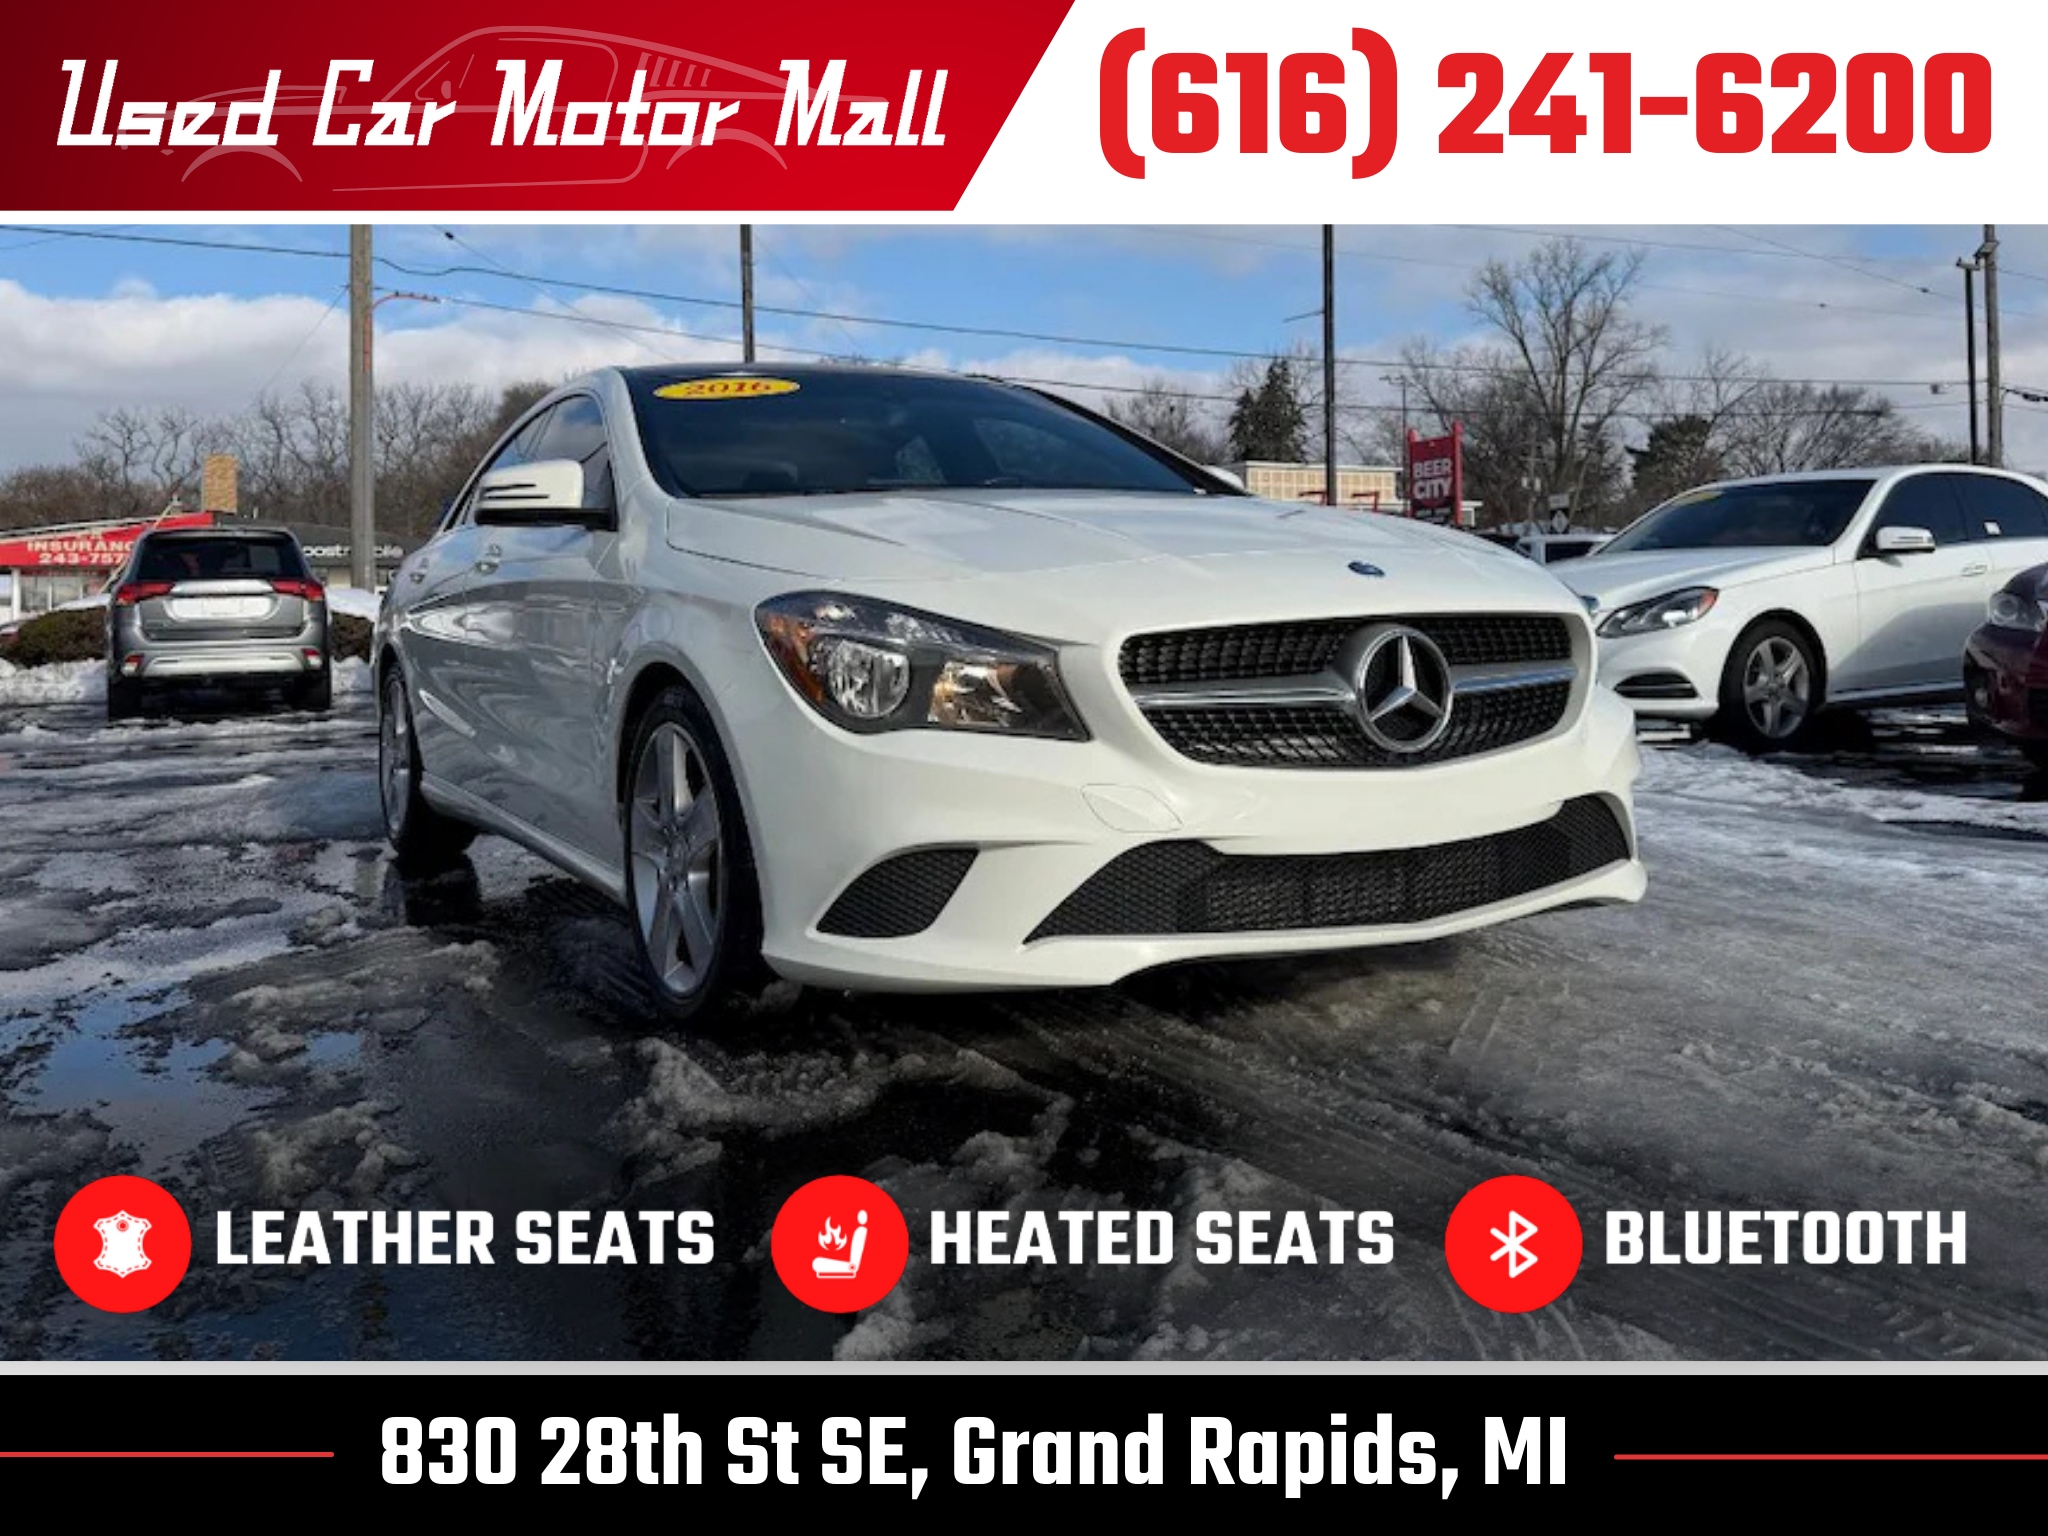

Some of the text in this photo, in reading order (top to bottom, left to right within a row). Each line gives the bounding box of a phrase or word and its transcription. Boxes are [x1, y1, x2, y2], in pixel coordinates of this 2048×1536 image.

[683, 381, 773, 395] 2016
[1413, 458, 1452, 479] BEER
[1413, 477, 1452, 499] CITY
[27, 540, 135, 552] INSURANC
[38, 553, 129, 565] 243-757
